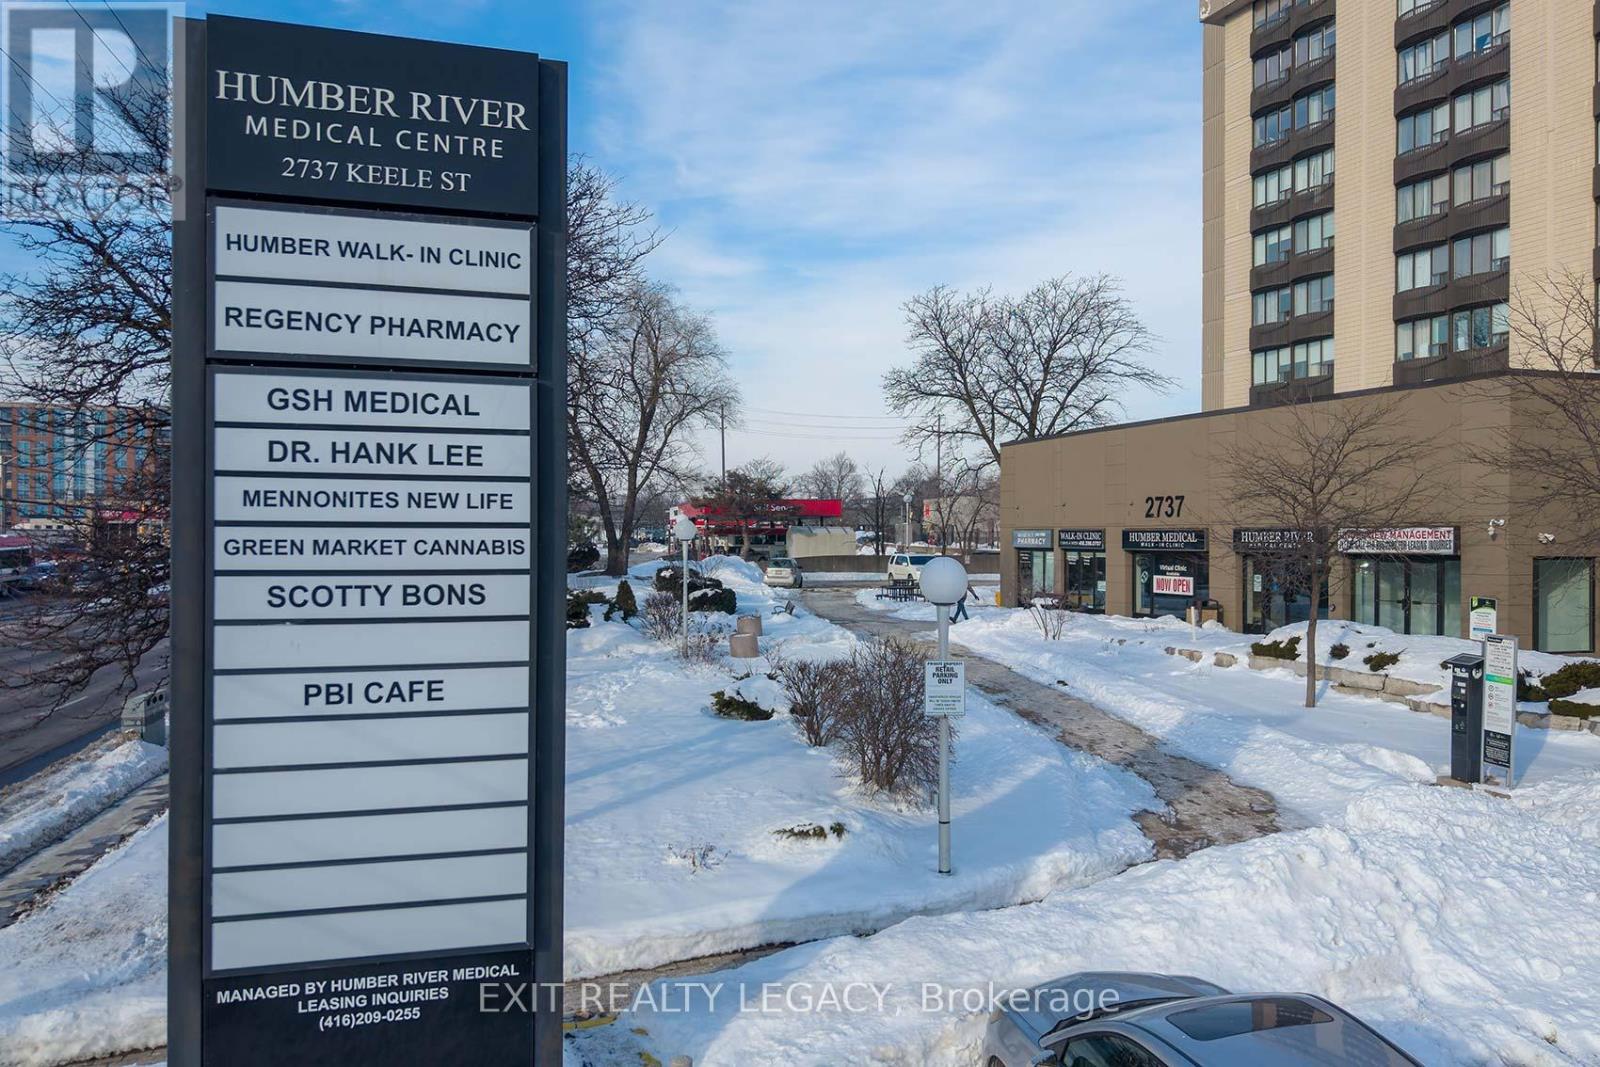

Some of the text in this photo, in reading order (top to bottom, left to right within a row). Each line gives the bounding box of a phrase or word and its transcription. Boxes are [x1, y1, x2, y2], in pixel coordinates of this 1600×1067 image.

[215, 69, 531, 131] HUMBER RIVER
[244, 115, 504, 159] MEDICAL CENTRE
[281, 157, 471, 192] 2737 KEELE ST
[226, 233, 330, 257] HUMBER
[448, 248, 522, 269] CLINIC
[225, 306, 520, 344] REGENCY PHARMACY
[267, 387, 480, 416] GSH MEDICAL
[268, 440, 483, 467] DR. HANK LEE
[242, 490, 513, 510] MENNONITES NEW LIFE
[1145, 495, 1185, 518] 2737
[223, 539, 525, 556] GREEN MARKET CANNABIS
[1017, 537, 1046, 545] PHARMACY
[1128, 532, 1198, 543] HUMBER MEDICAL
[1241, 531, 1314, 543] HUMBER RIVR
[1390, 530, 1452, 540] MANAGEMENT
[267, 583, 486, 608] SCOTTY BONS
[1156, 577, 1191, 593] NOW OPEN
[304, 680, 444, 706] PBI CAFE
[216, 964, 519, 1004] MANAGED BY HUMBER RIVER MEDICAL
[298, 987, 449, 1013] LEASING INQUIRIES
[319, 1007, 421, 1031] (416)209-0255
